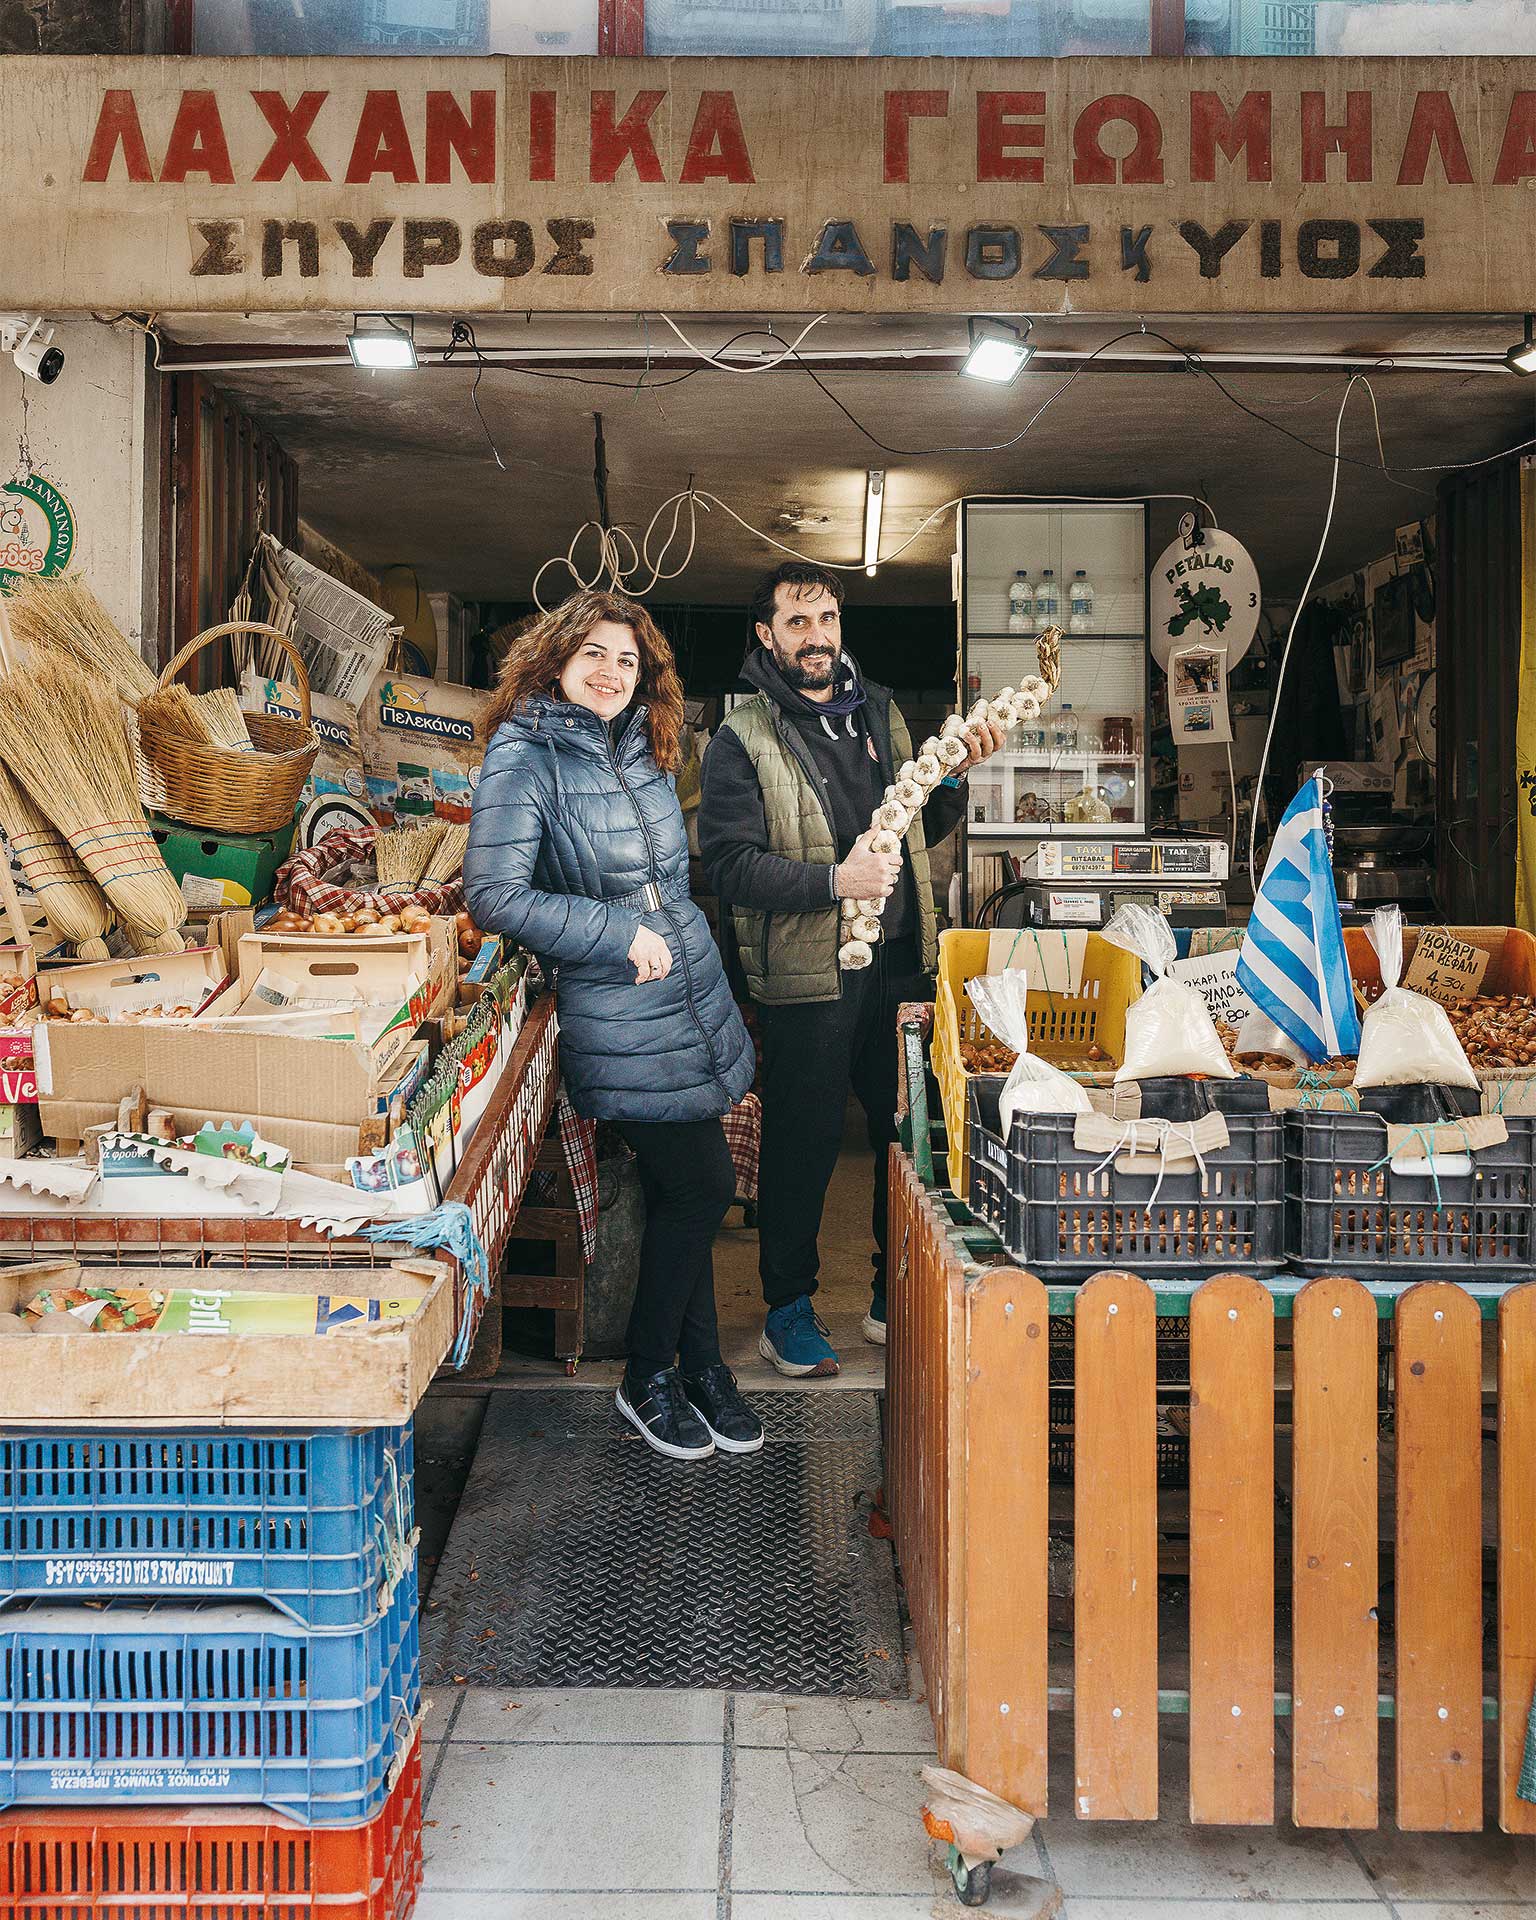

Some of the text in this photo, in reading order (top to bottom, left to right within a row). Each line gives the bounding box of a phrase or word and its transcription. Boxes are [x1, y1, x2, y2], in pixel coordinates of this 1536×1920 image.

[83, 90, 755, 184] ΛΑΧΑΝΙΚΑ
[189, 217, 595, 278] ΣΠΥΡΟΣ
[1165, 553, 1234, 585] PETALAS
[1248, 592, 1257, 608] 3
[382, 706, 472, 740] Πελεκάνος
[1075, 846, 1101, 854] TAXI
[1423, 933, 1476, 960] ΚΟΚΑΡΙ
[1418, 948, 1478, 975] ΓΙΑ ΚΕΦΑΛΙ
[1207, 1000, 1231, 1012] ΦΑΛΙ
[2, 1073, 38, 1103] Ve
[51, 1776, 109, 1789] ΠΡΕΒΕΖΑΣ
[167, 1774, 230, 1787] ΑΓΡΟΤΙΚΟΣ
